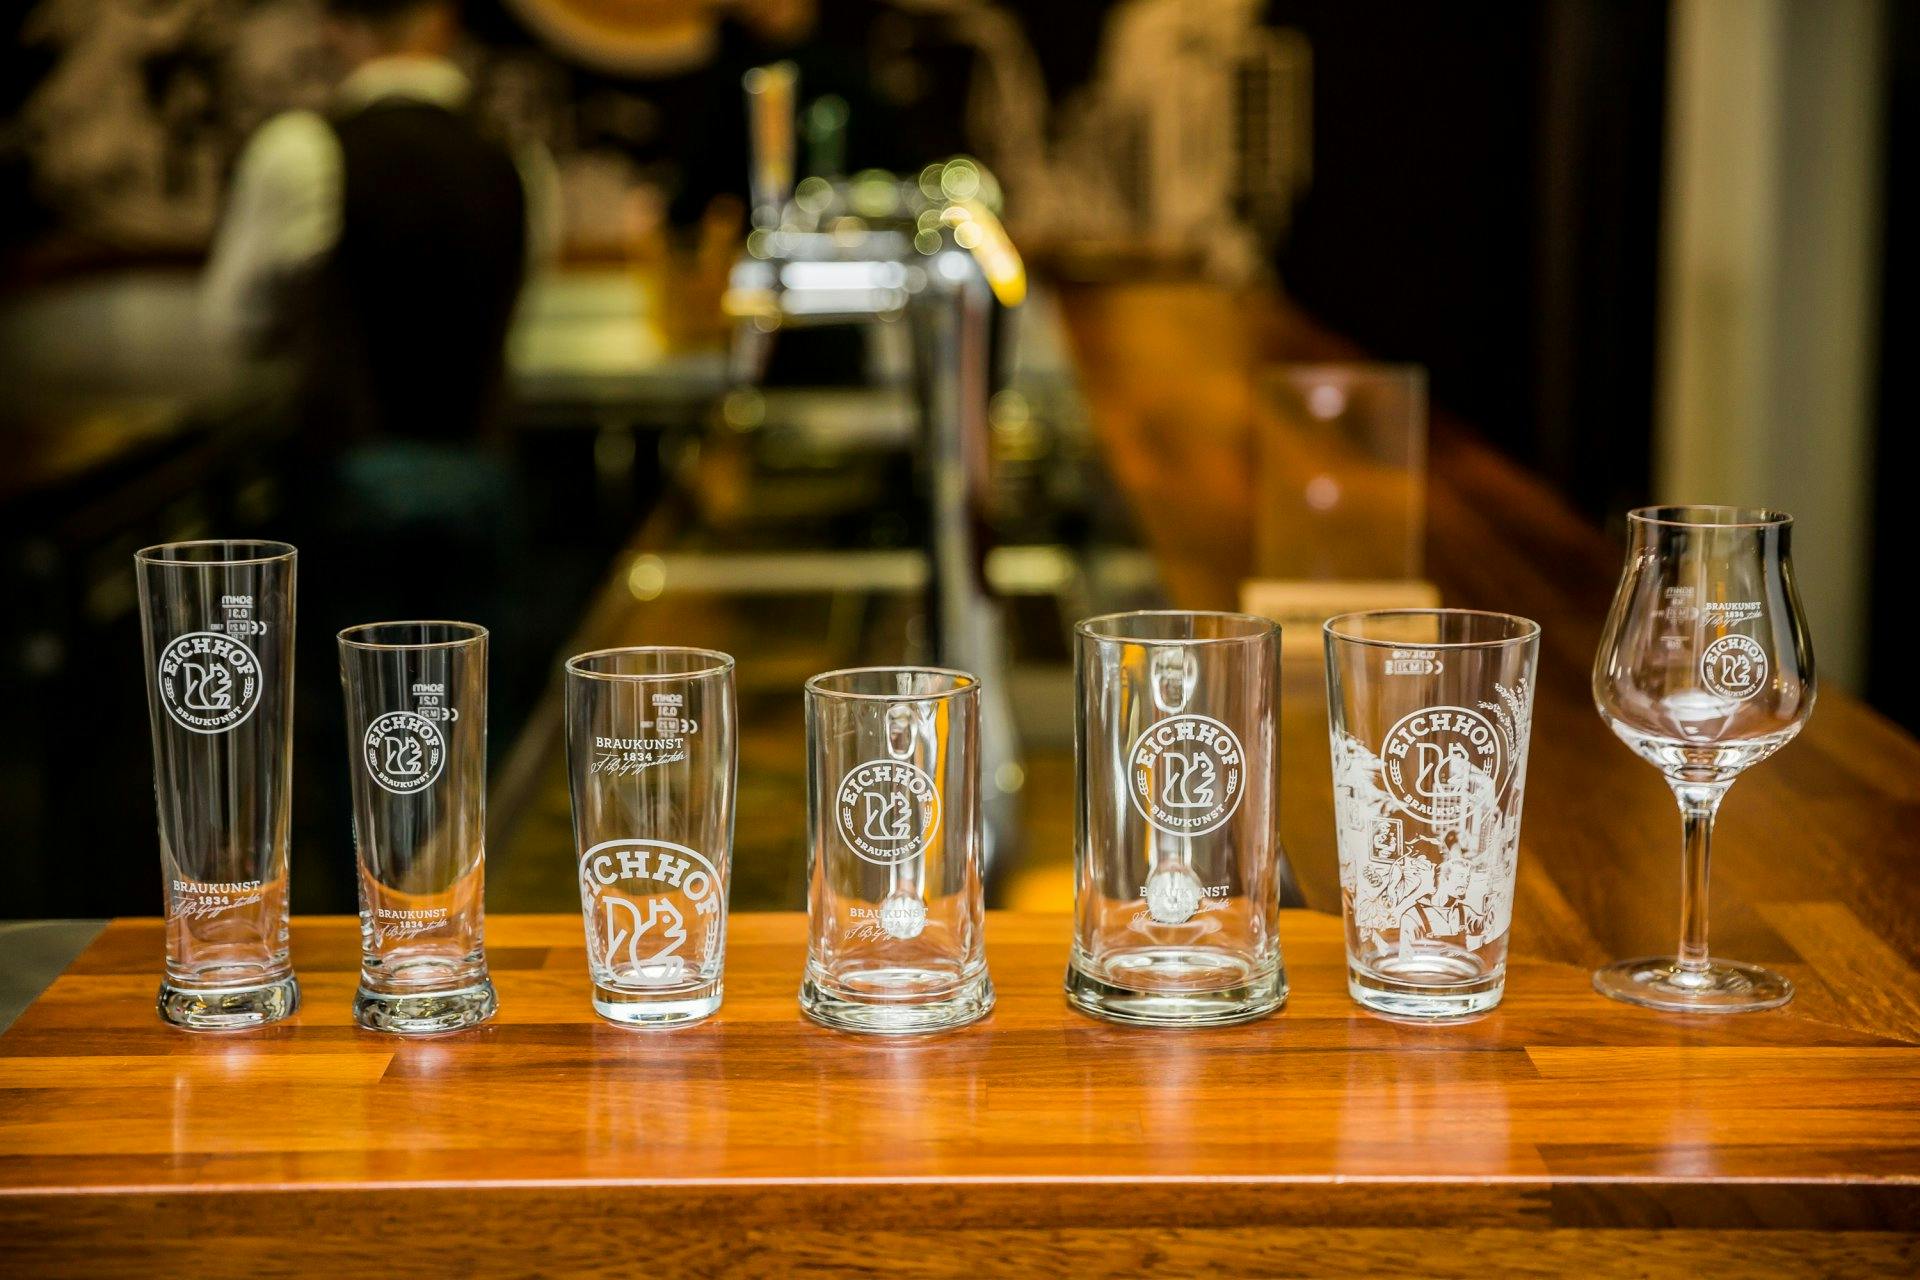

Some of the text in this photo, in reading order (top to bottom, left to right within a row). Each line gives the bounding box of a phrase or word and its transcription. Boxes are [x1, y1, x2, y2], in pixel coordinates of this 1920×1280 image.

[163, 638, 255, 676] EICHHOF
[1706, 638, 1763, 665] EICHHOF
[176, 706, 242, 726] BRAUKUNST
[368, 716, 440, 748] EICHHOF
[1388, 713, 1495, 759] EICHHOF
[596, 737, 683, 750] BRAUKUNST
[1136, 722, 1239, 768] EICHHOF
[622, 752, 652, 761] 1834
[377, 772, 431, 788] BRAUKUNST
[842, 766, 933, 806] EICHHOF
[1151, 803, 1225, 827] BRAUKUNST
[854, 836, 921, 857] BRAUKUNST
[173, 880, 260, 893] BRAUKUNST
[199, 896, 229, 905] 1834
[378, 908, 448, 919] BRAUKUNST
